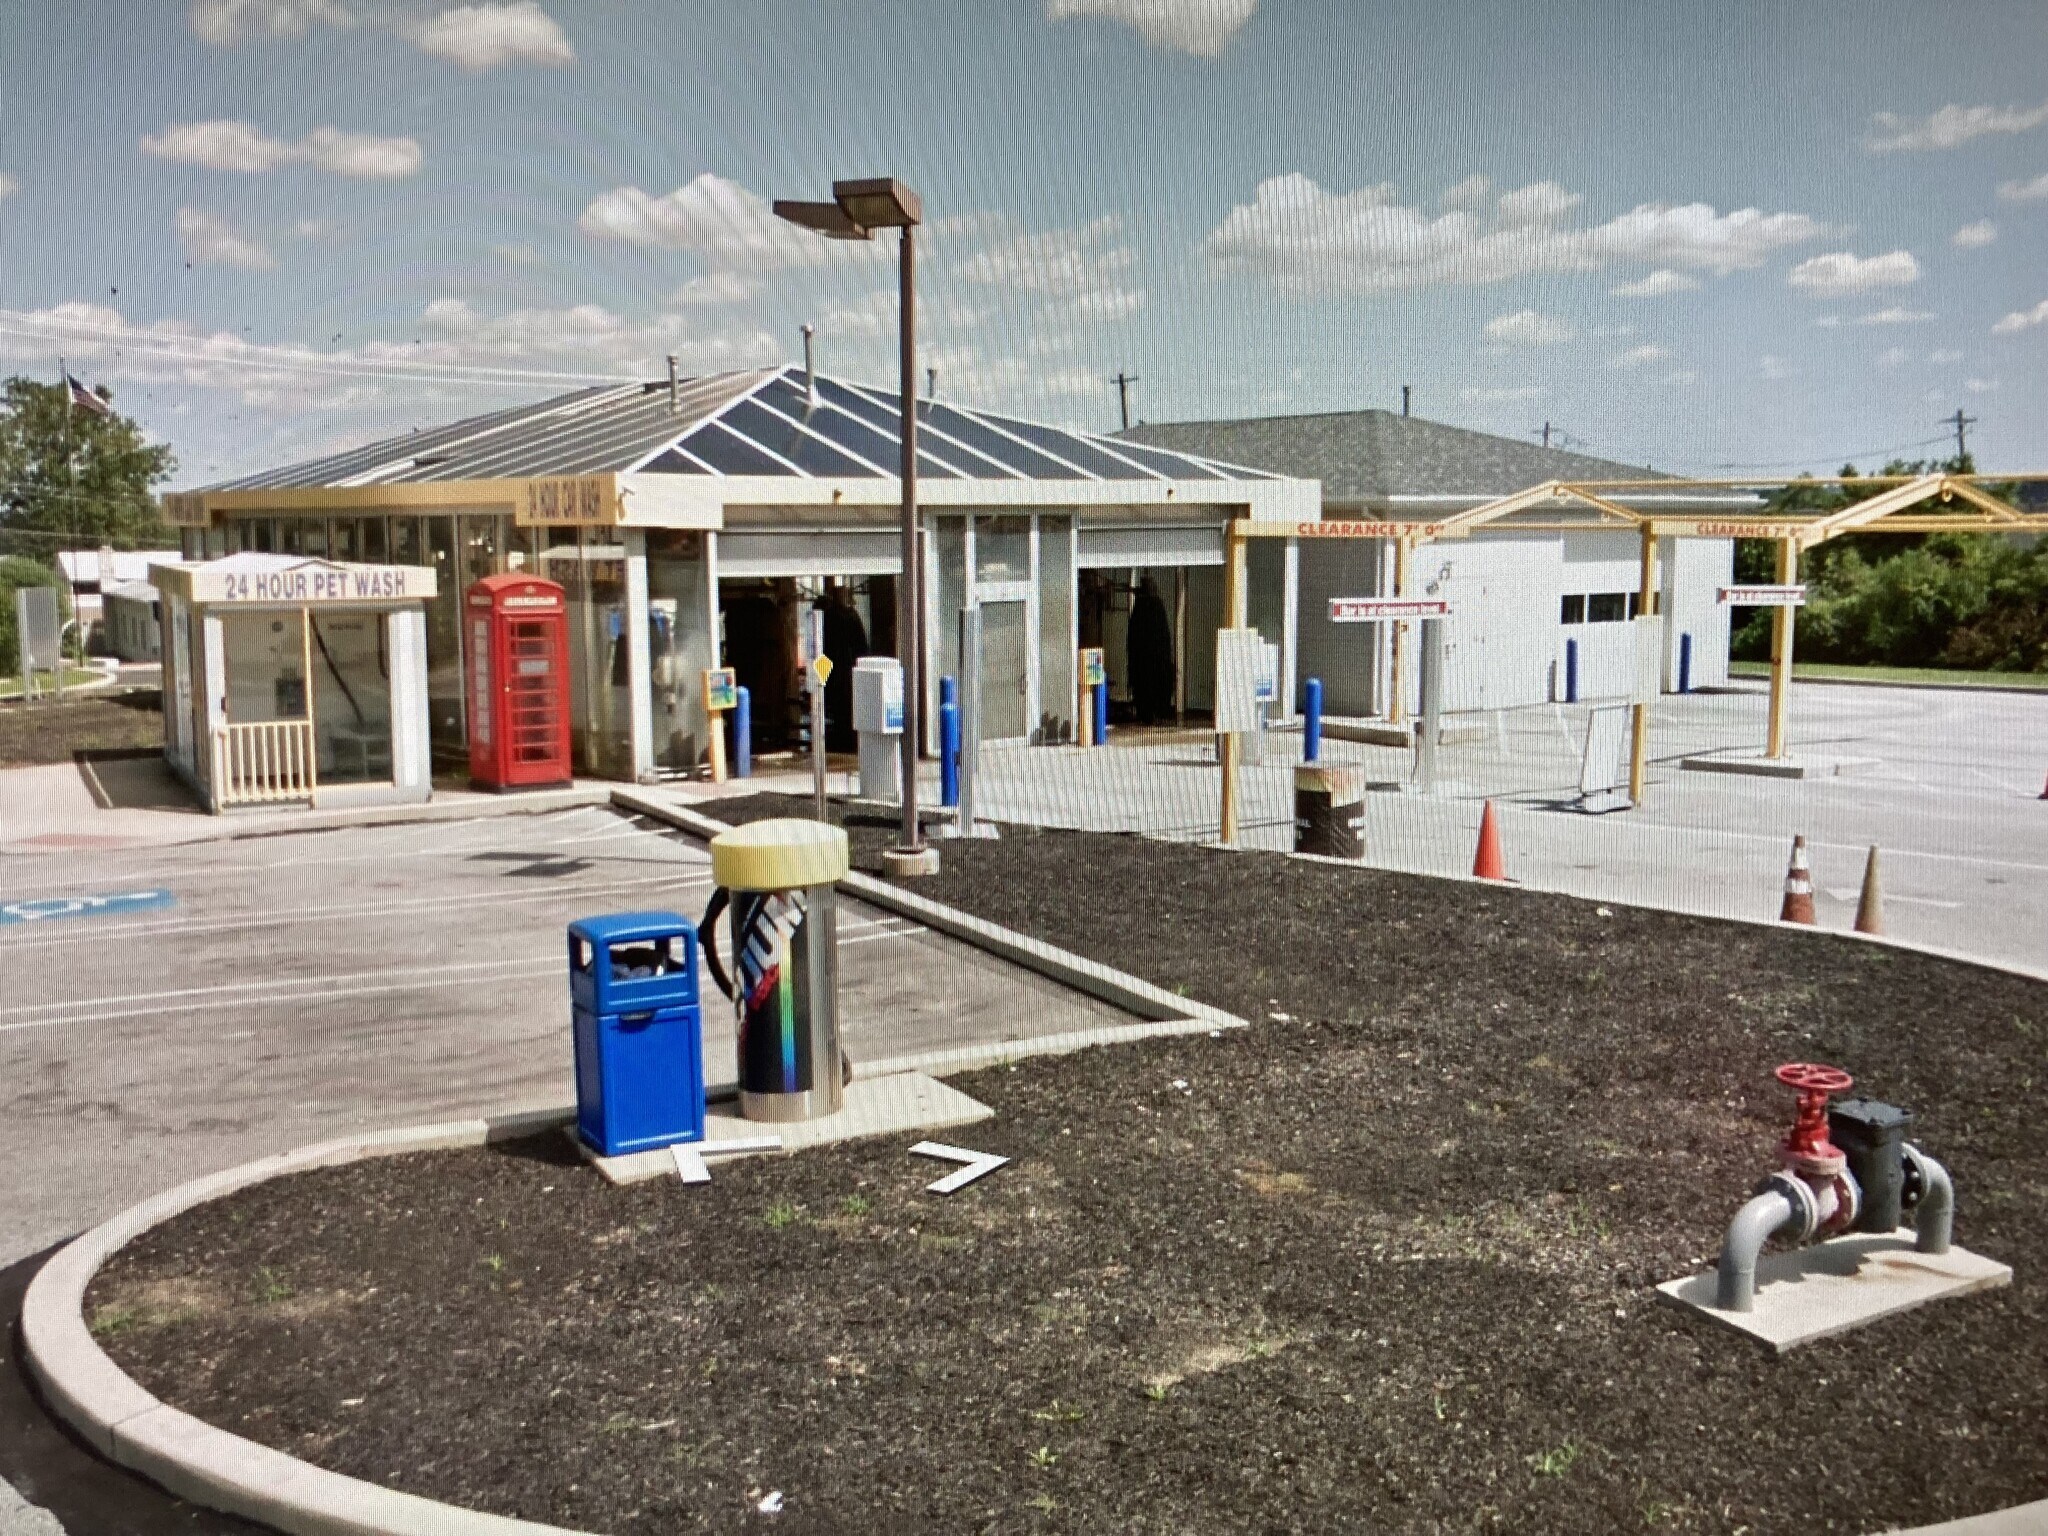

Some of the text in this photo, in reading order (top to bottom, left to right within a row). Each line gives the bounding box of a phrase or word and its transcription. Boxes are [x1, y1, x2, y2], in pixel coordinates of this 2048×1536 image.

[1297, 522, 1397, 537] CLEARANCE
[1697, 523, 1769, 536] CLEARANCE
[225, 571, 405, 599] 24 HOUR PET WASH
